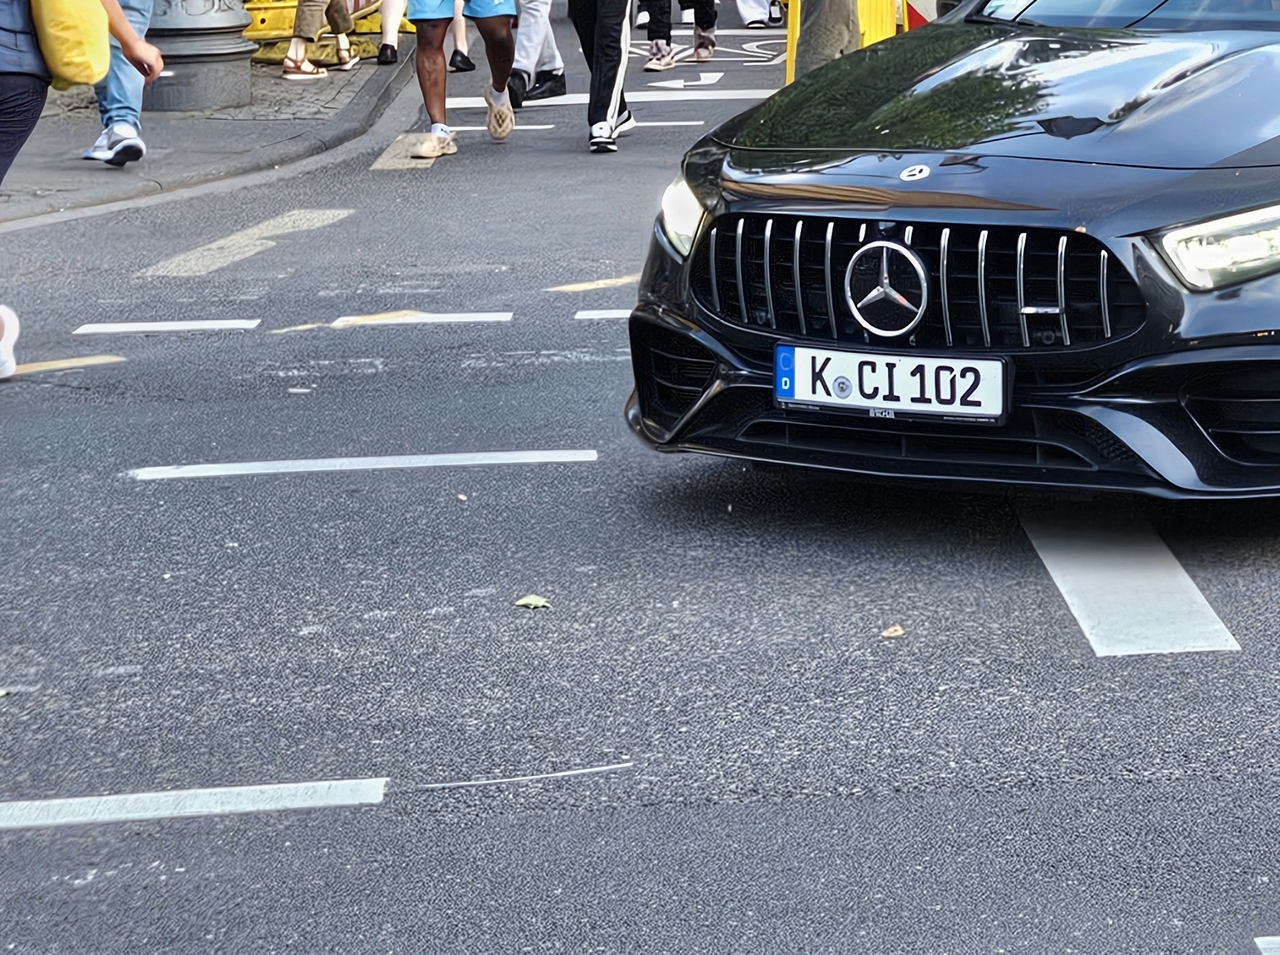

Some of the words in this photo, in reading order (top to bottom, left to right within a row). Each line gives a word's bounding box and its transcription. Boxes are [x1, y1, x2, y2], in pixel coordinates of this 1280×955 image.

[782, 377, 790, 390] D
[811, 356, 832, 397] K
[858, 360, 901, 402] CI
[910, 364, 982, 407] 102
